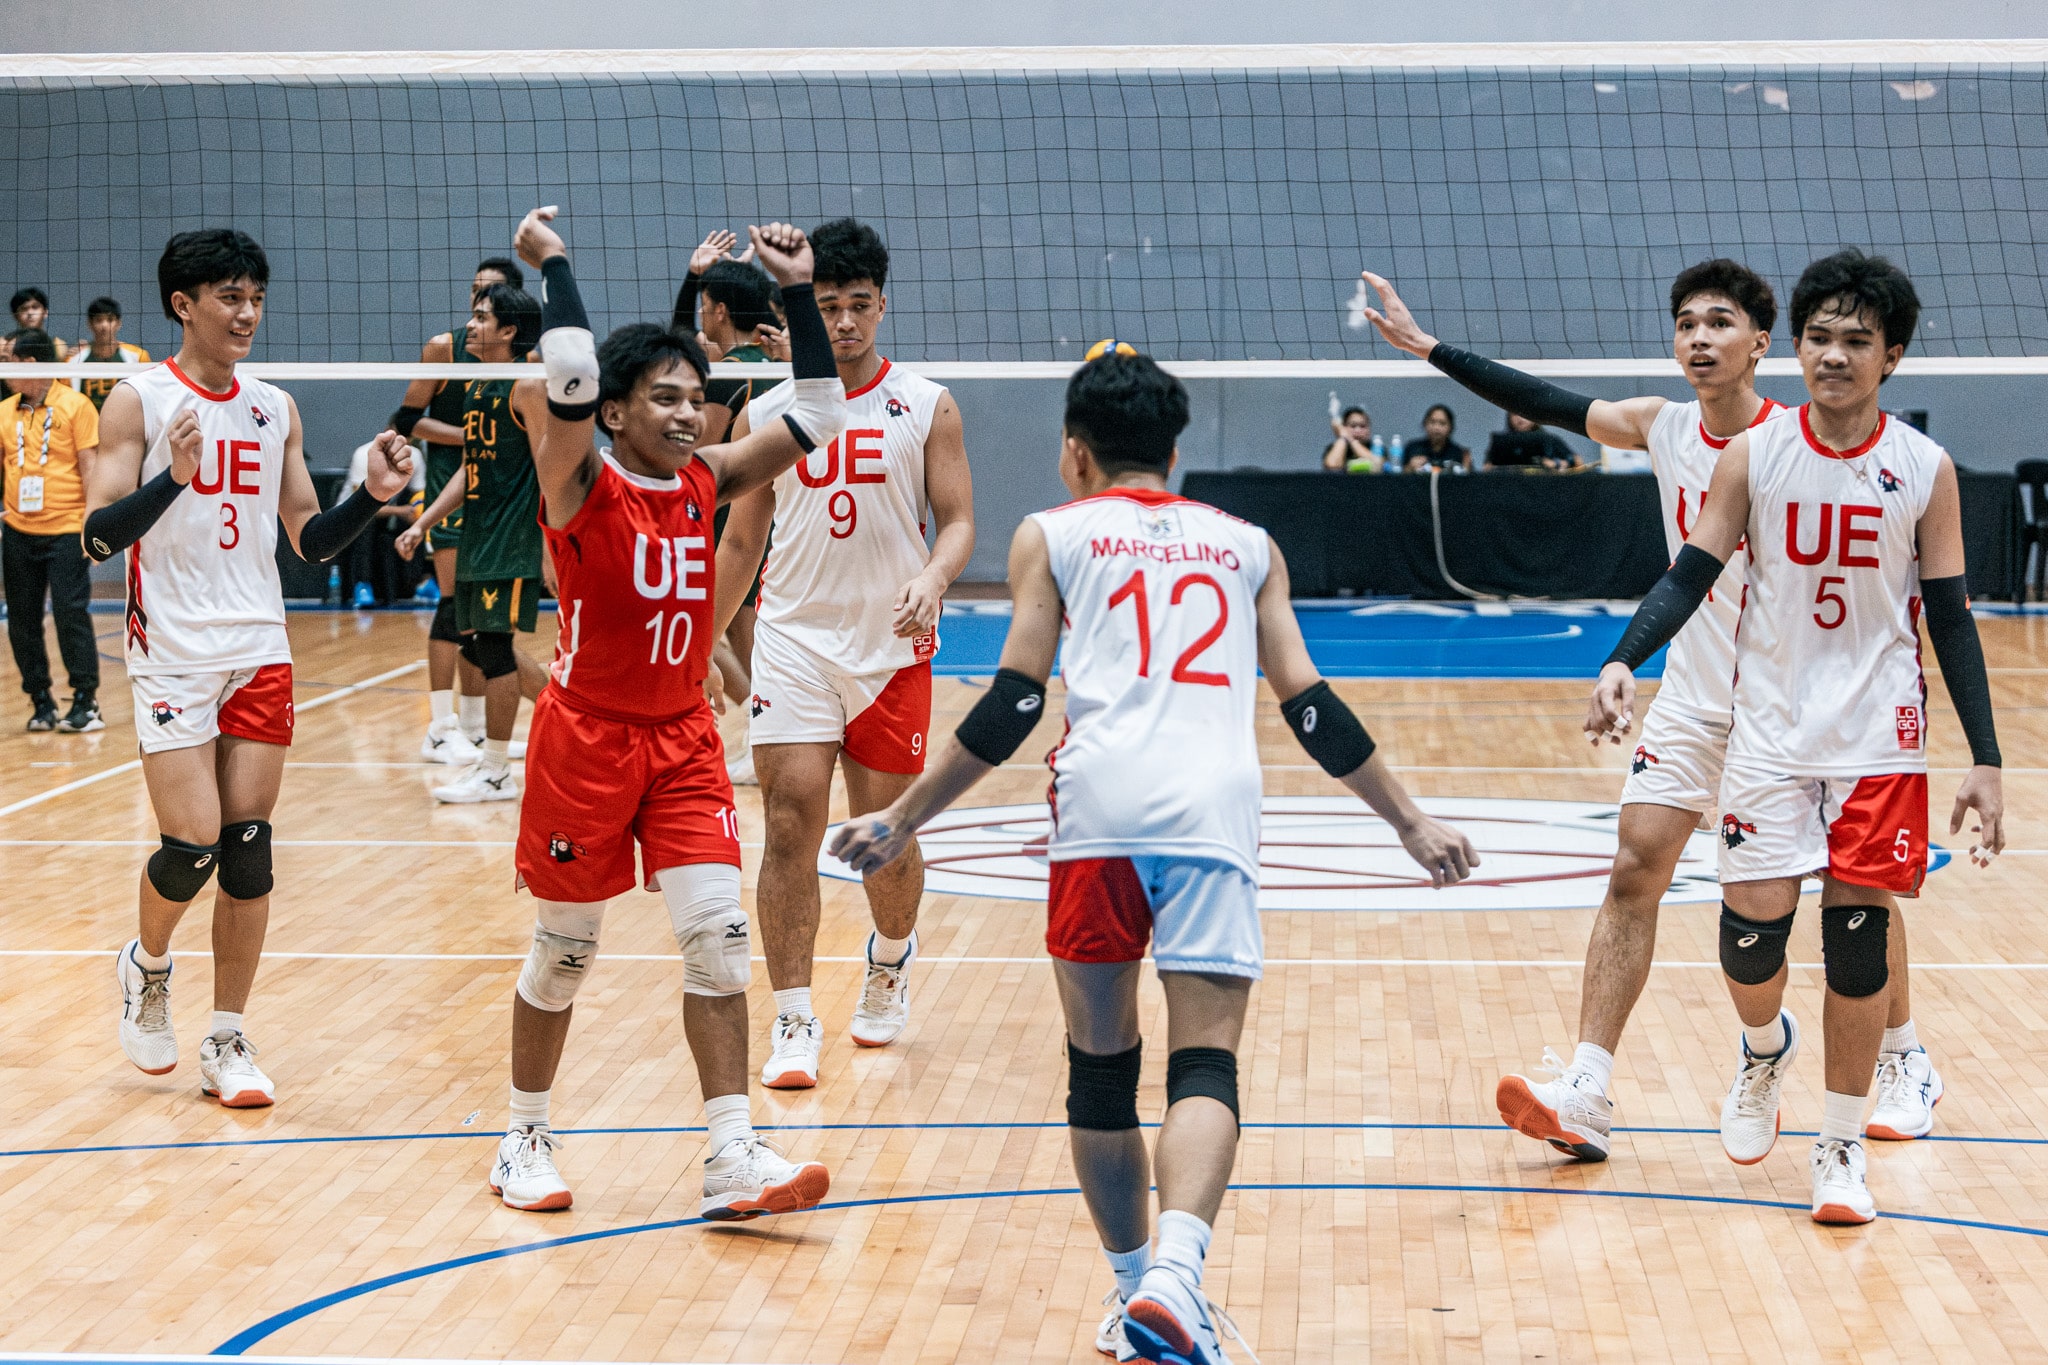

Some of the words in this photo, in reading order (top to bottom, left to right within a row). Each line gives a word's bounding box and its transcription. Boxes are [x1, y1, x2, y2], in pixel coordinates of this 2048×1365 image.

[85, 377, 117, 396] FE
[191, 439, 261, 495] UE
[795, 429, 886, 489] UE
[219, 502, 239, 550] 3
[828, 490, 857, 540] 9
[1786, 502, 1883, 569] UE
[634, 532, 707, 600] UE
[1090, 536, 1241, 571] MARCELINO
[1813, 576, 1847, 630] 5
[645, 610, 693, 666] 10
[913, 635, 932, 646] GO
[1108, 569, 1231, 688] 12
[1897, 707, 1916, 719] LO
[1897, 719, 1917, 730] GO
[911, 732, 922, 756] 9
[1893, 829, 1910, 863] 5
